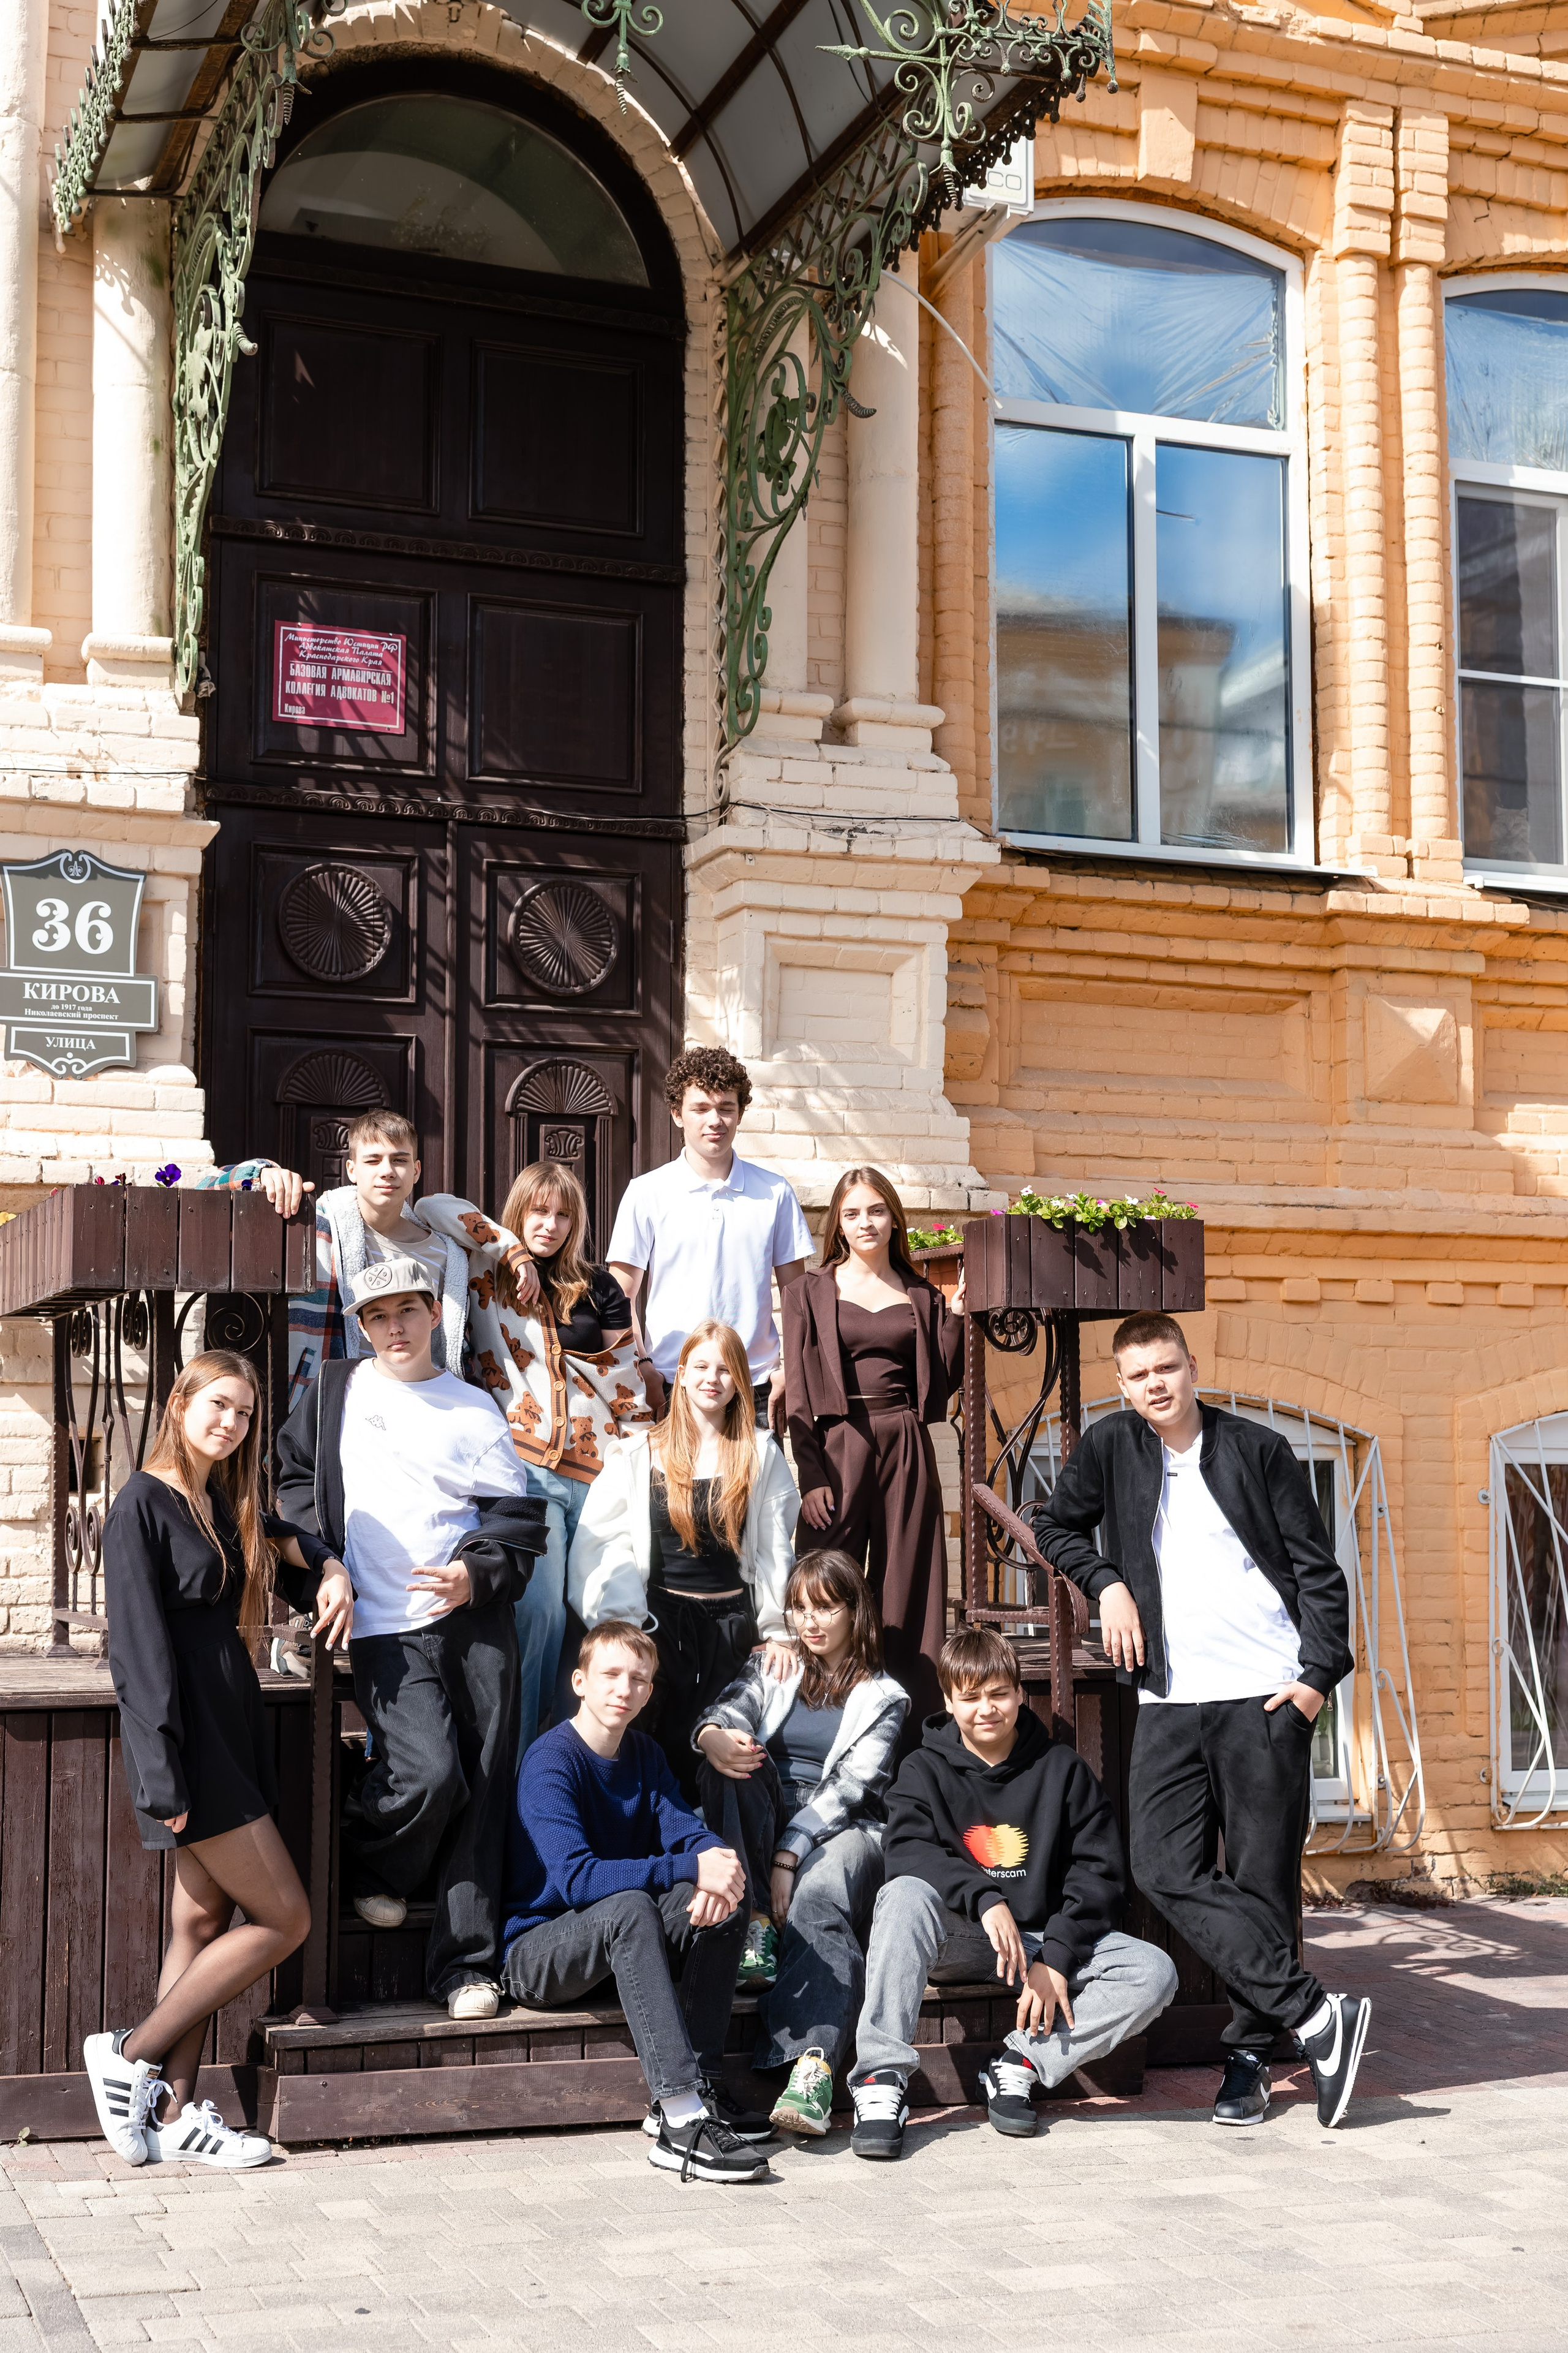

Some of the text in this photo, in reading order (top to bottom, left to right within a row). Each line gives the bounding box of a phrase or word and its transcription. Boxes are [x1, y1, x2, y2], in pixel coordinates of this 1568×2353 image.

[299, 641, 383, 658] Адвокатская Палата
[343, 637, 379, 649] Юстиции
[380, 641, 398, 653] РФ
[299, 649, 382, 667] Краснодарского Края
[290, 663, 391, 686] БАЗОВАЯ АРМАВИРСКАЯ
[285, 681, 394, 704] КОЛЛЕГИЯ АДВОКАТОВ №1
[284, 703, 306, 715] Кирова
[32, 898, 114, 954] 36
[23, 982, 121, 1004] КИРОВА
[24, 1008, 81, 1018] Николаевский
[45, 1037, 96, 1051] УЛИЦА
[981, 1865, 1027, 1878] terscam
